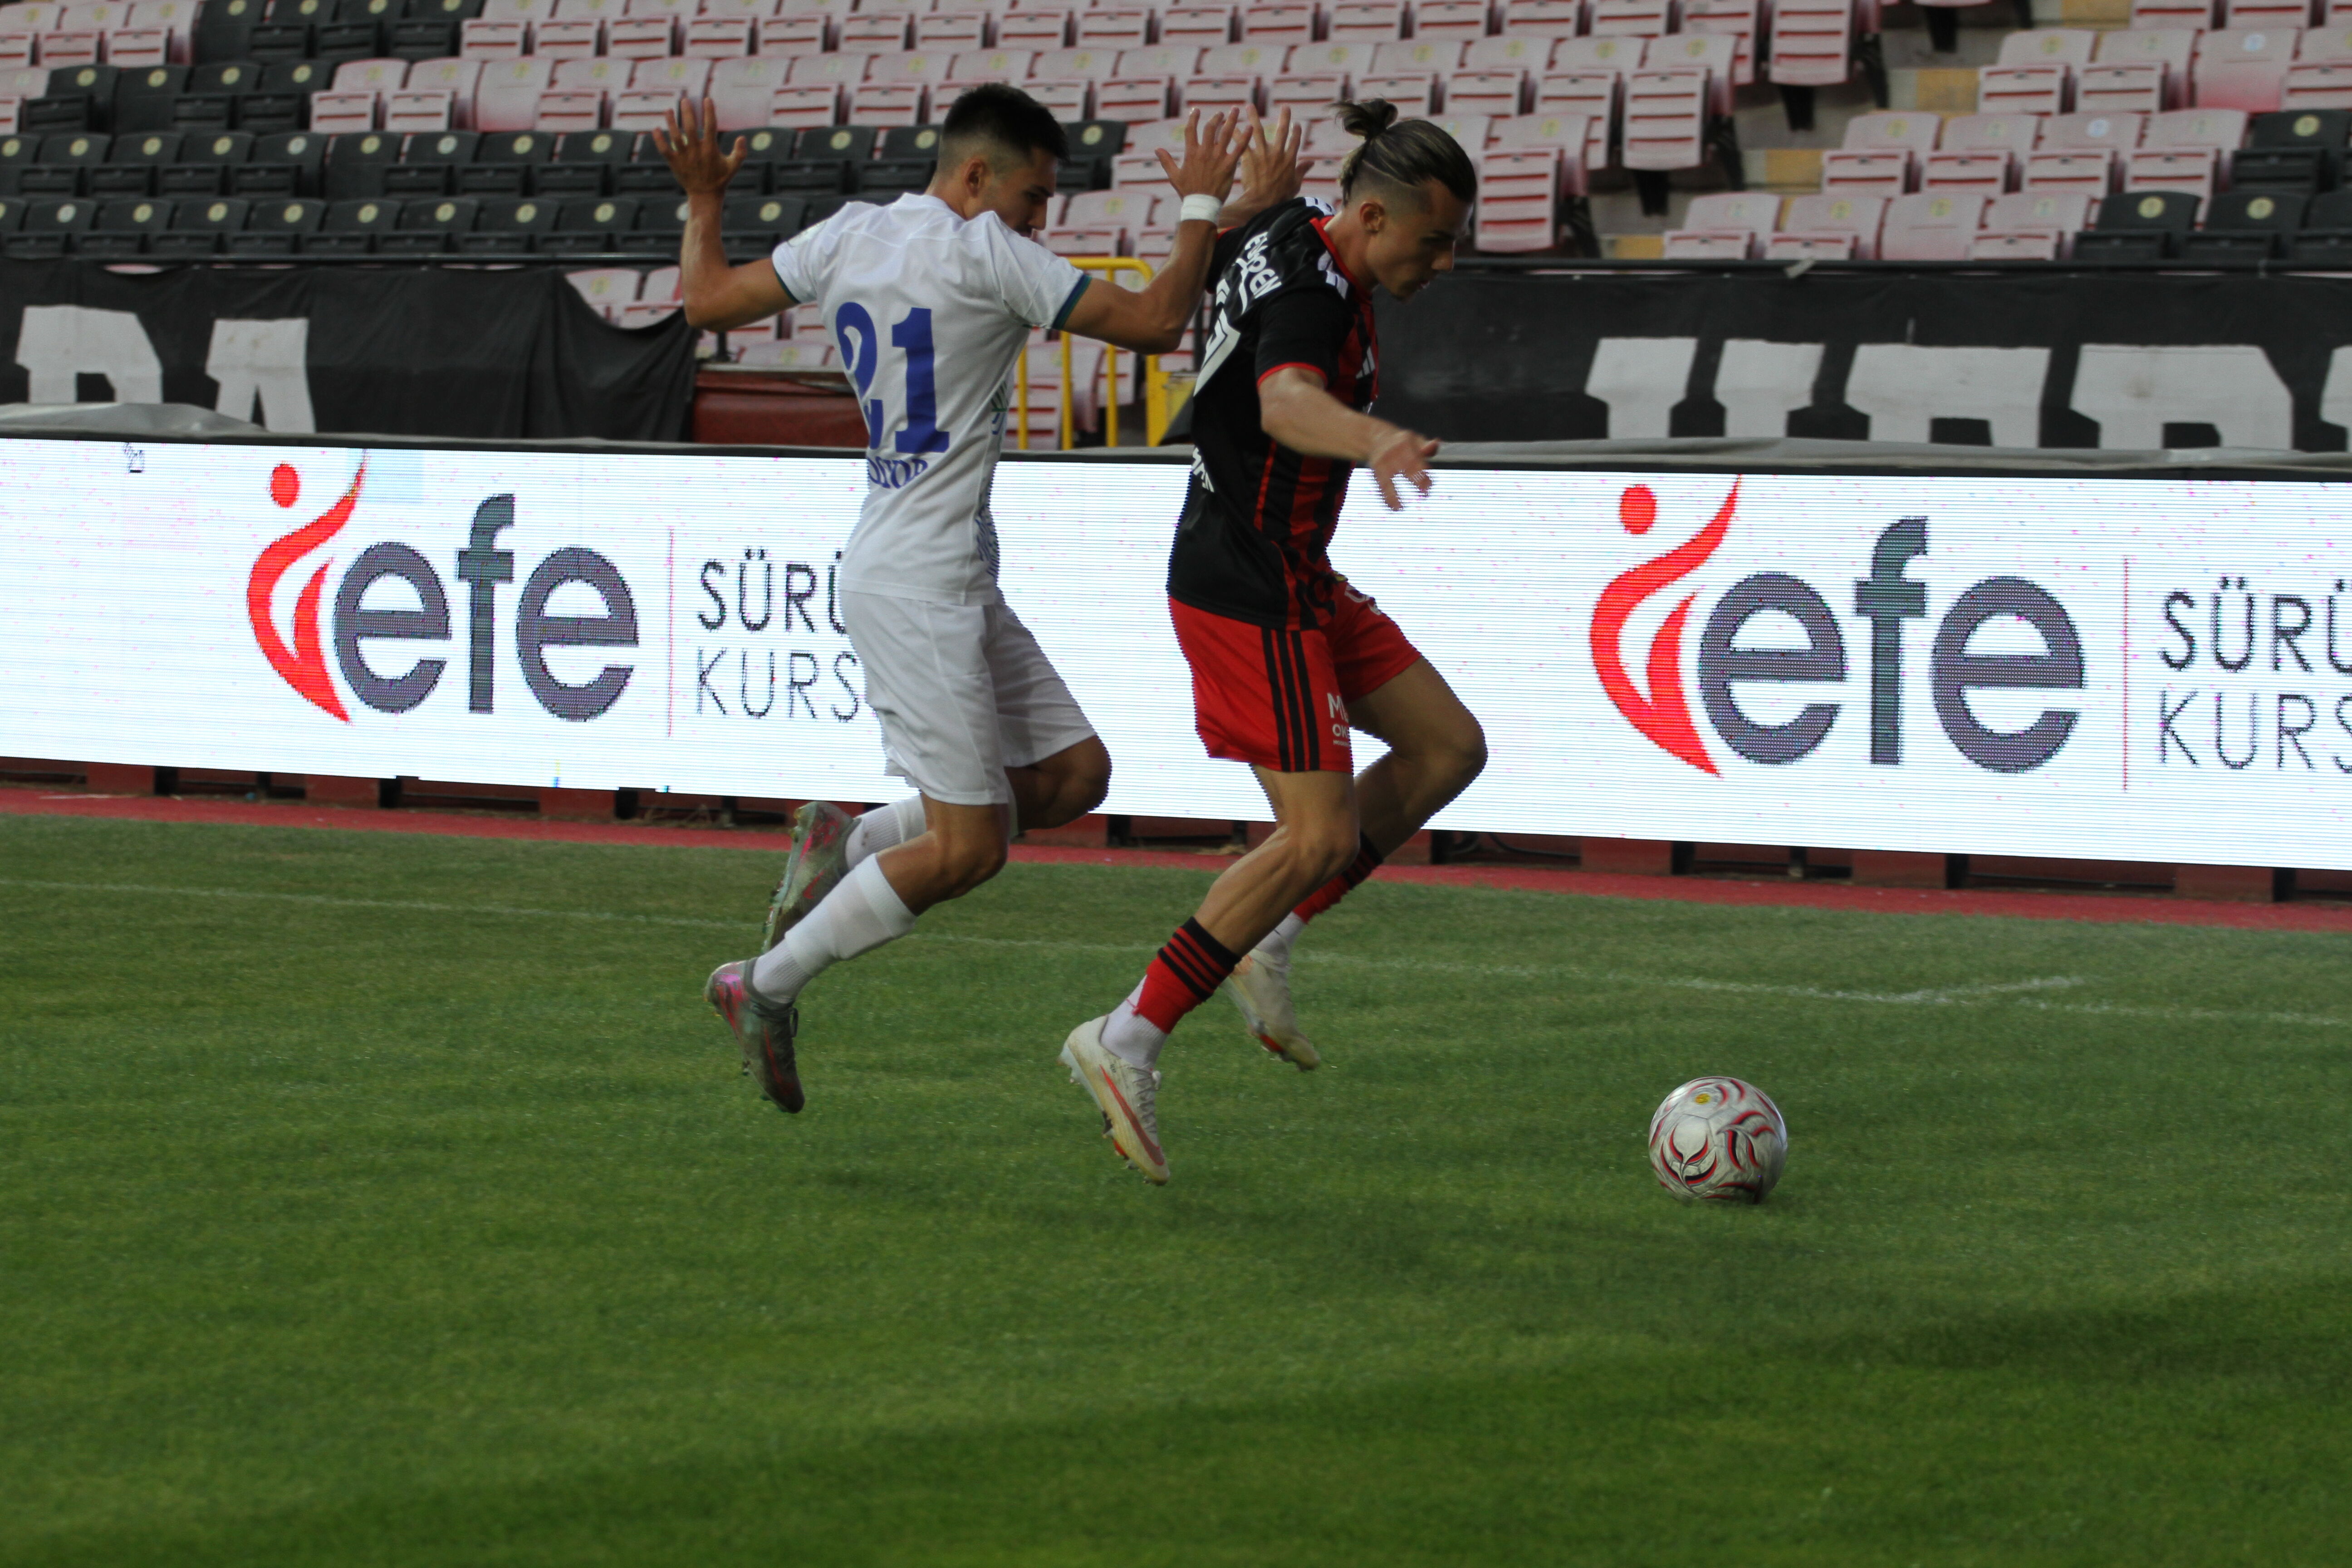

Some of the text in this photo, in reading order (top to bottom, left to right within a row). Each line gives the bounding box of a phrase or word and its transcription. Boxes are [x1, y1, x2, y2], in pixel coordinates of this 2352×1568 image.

[836, 302, 950, 454] 21
[333, 493, 639, 722] efe
[1698, 515, 2087, 773] efe
